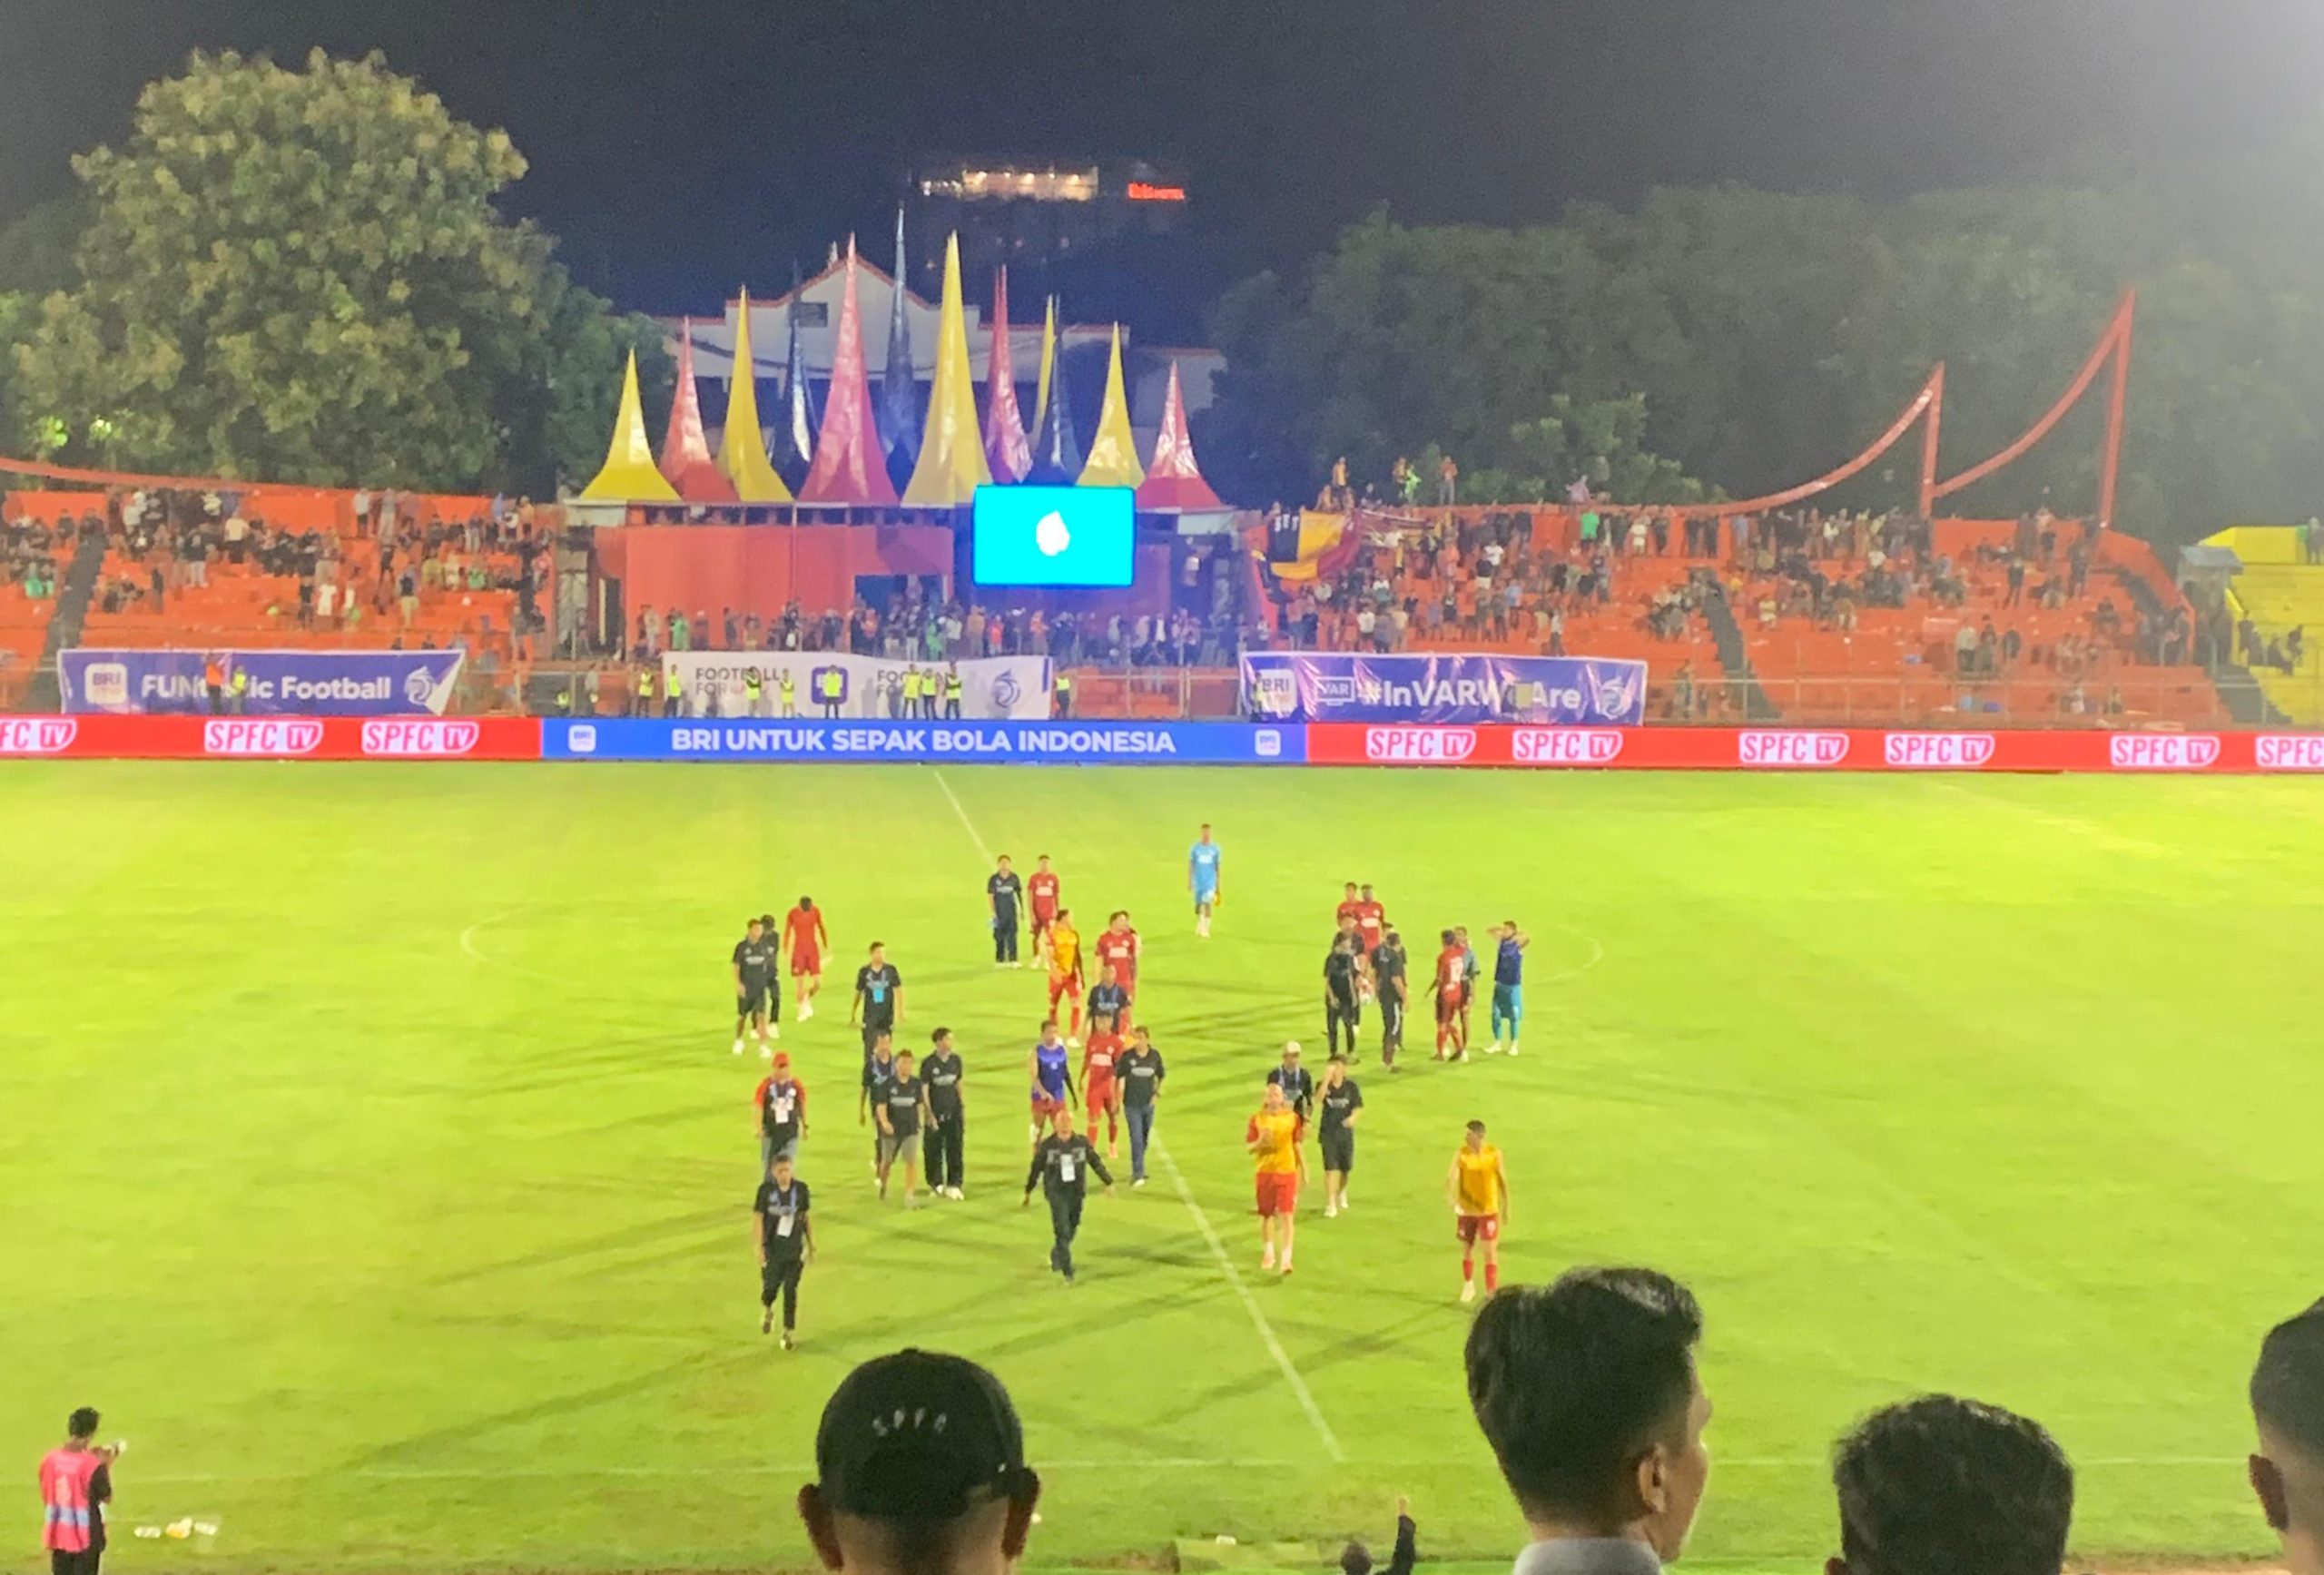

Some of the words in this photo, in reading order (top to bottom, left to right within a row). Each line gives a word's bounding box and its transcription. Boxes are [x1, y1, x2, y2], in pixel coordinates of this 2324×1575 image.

[695, 667, 780, 681] FOOTLL
[281, 676, 391, 699] Football
[44, 725, 67, 745] TV
[209, 724, 277, 750] SPFC
[290, 726, 314, 747] TV
[366, 724, 435, 751] SPFC
[446, 727, 470, 748] TV
[671, 728, 720, 751] BRI
[725, 729, 825, 752] UNTUK
[832, 729, 927, 752] SEPAK
[932, 730, 1012, 752] BOLA
[1019, 731, 1177, 753] INDONESIA
[1371, 731, 1434, 756] SPFC
[1445, 734, 1467, 755] TV
[1517, 733, 1580, 758] SPFC
[1591, 735, 1613, 757] TV
[1744, 735, 1807, 761] SPFC
[1818, 739, 1840, 759] TV
[1889, 737, 1952, 762] SPFC
[1964, 741, 1985, 761] TV
[2115, 738, 2179, 763] SPFC
[2191, 742, 2211, 762] TV
[2260, 739, 2324, 764] SPFC
